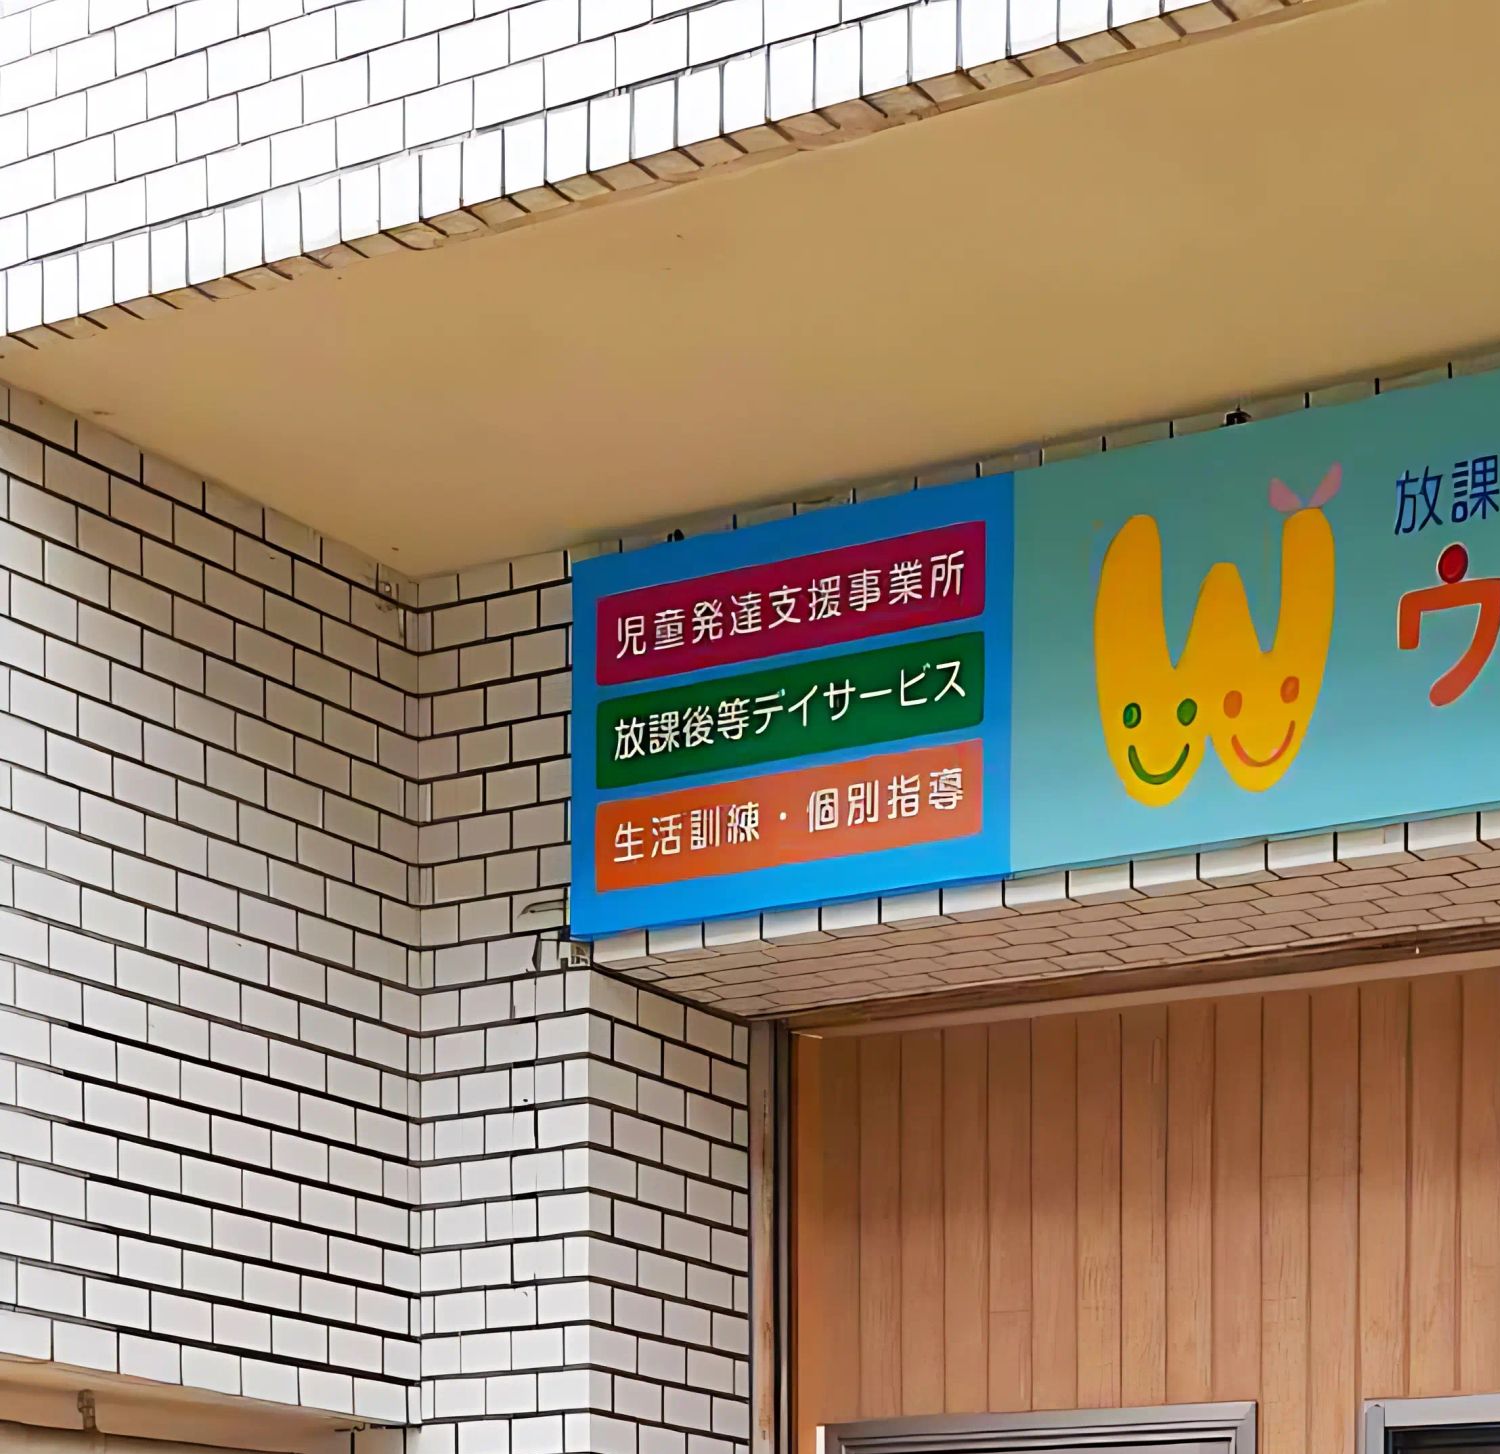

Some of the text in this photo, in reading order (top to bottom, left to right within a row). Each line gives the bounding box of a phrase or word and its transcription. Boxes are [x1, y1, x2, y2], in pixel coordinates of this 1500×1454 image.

[615, 549, 966, 659] 児童発達支援事業所
[614, 659, 967, 761] 放課後等デイサービス
[613, 767, 964, 863] 生活訓練・個別指導
